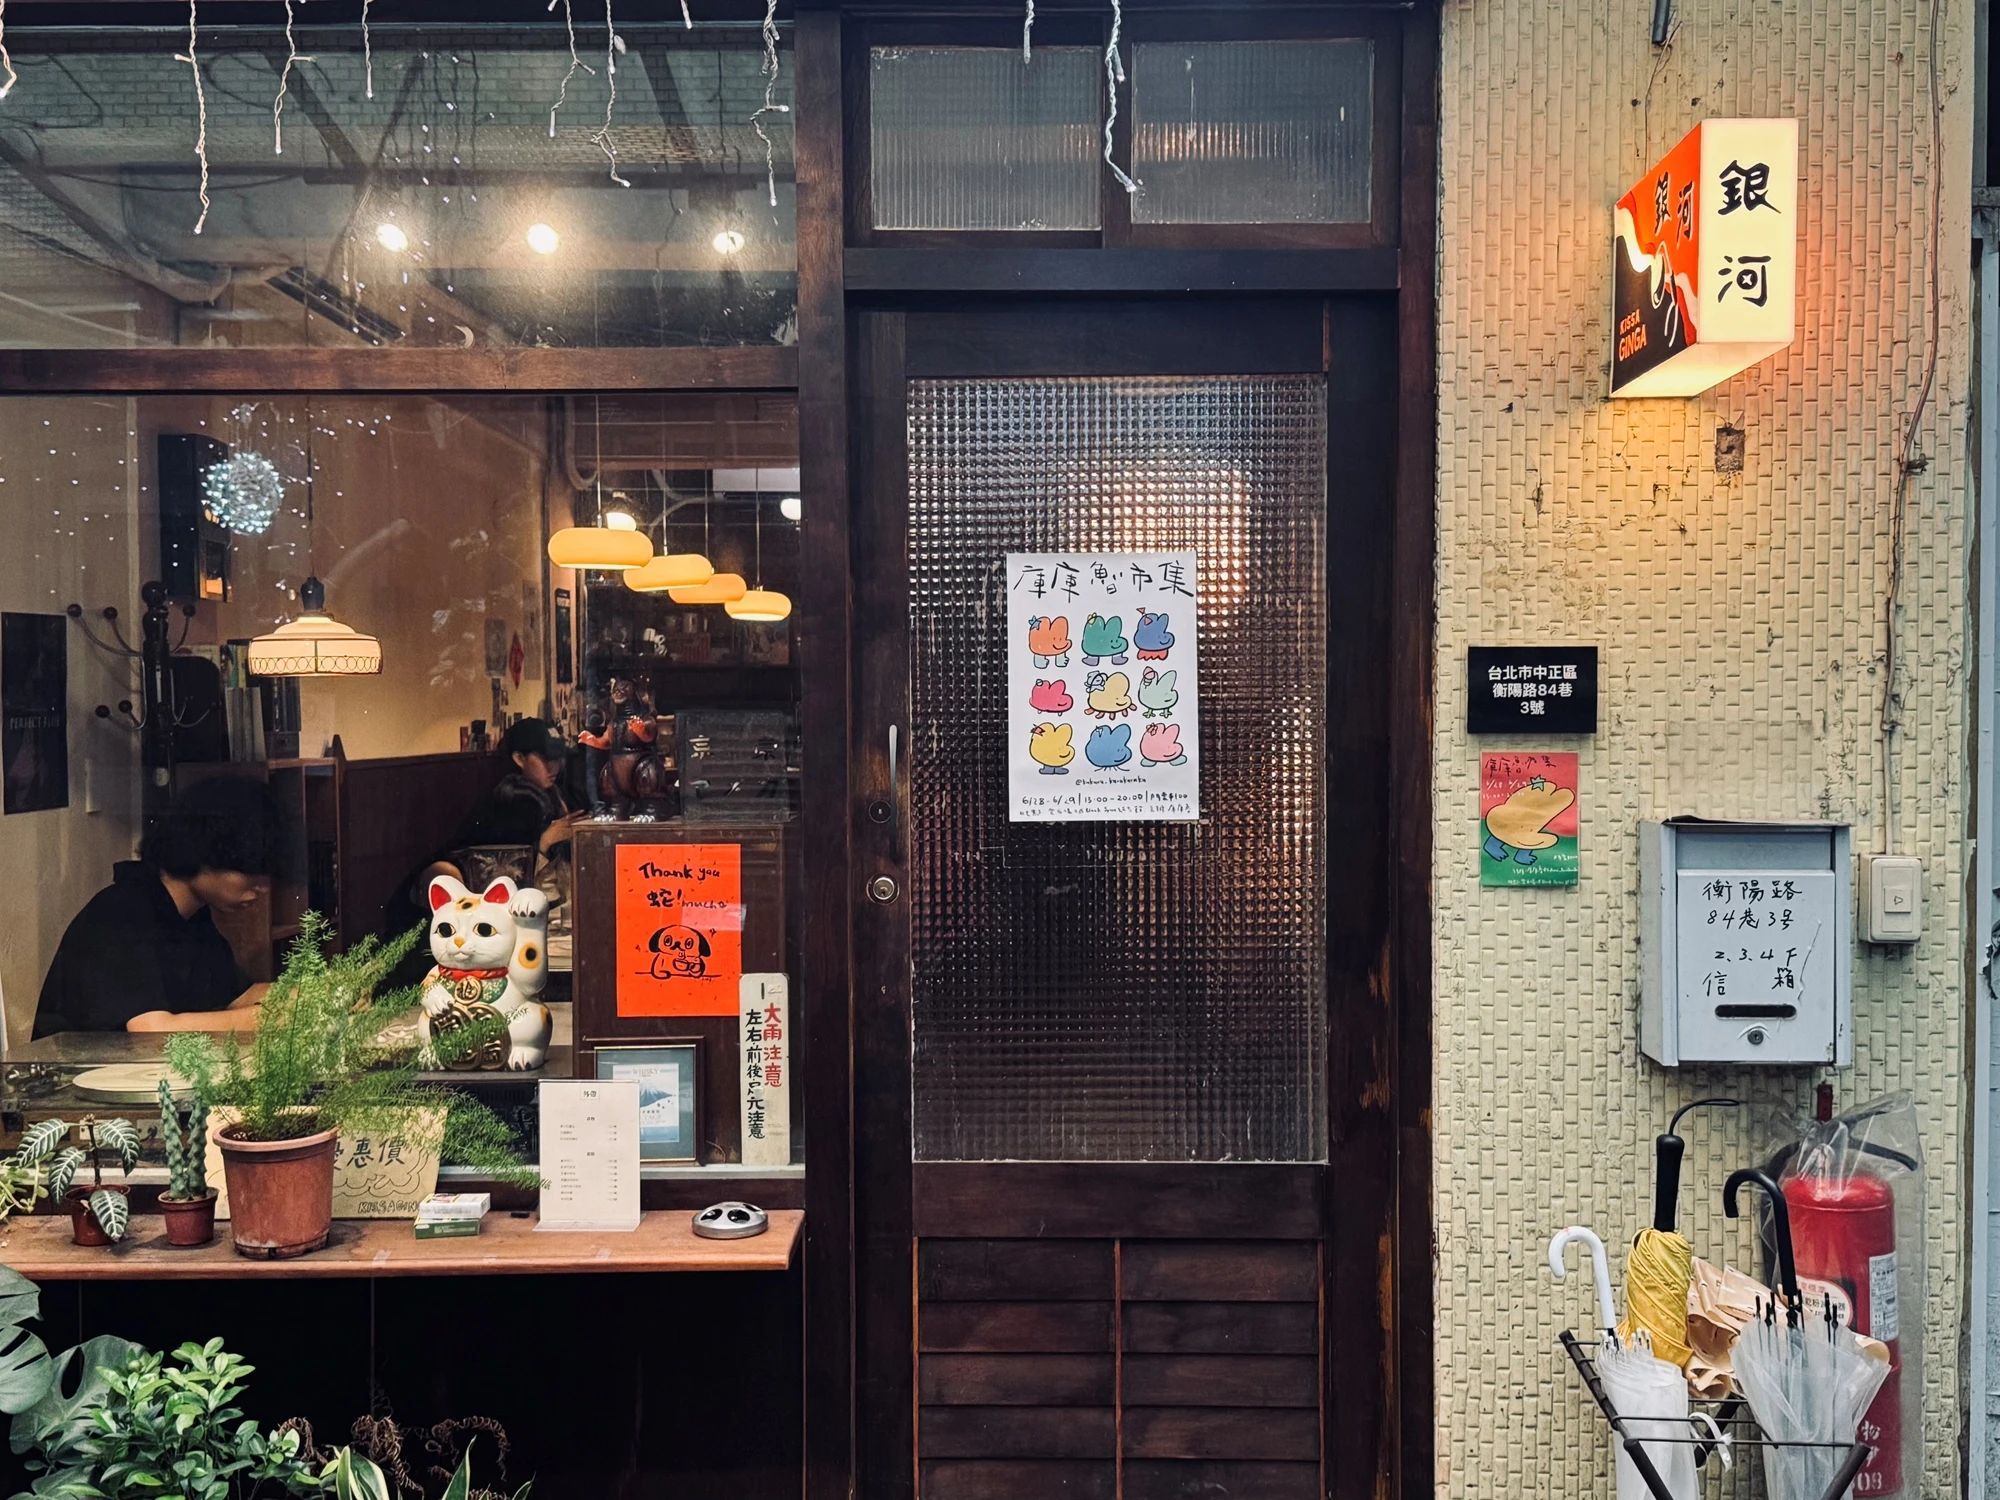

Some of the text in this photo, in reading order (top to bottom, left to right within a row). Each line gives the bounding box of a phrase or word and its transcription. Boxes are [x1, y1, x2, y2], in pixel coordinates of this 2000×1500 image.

[1654, 171, 1695, 248] 銀河
[1718, 160, 1781, 307] 銀河
[1620, 309, 1640, 335] KISSA
[1619, 324, 1647, 361] GINGA
[1488, 664, 1578, 681] 台北市中正區
[1492, 683, 1573, 698] 衡陽路84巷
[1520, 701, 1545, 715] 3號
[638, 862, 721, 881] Thank you
[1702, 879, 1803, 905] 衡陽路
[763, 1002, 783, 1088] 大雨注意
[632, 1067, 659, 1075] WHISKY
[358, 1199, 419, 1214] KISSAGIN
[1852, 1472, 1882, 1490] 08
